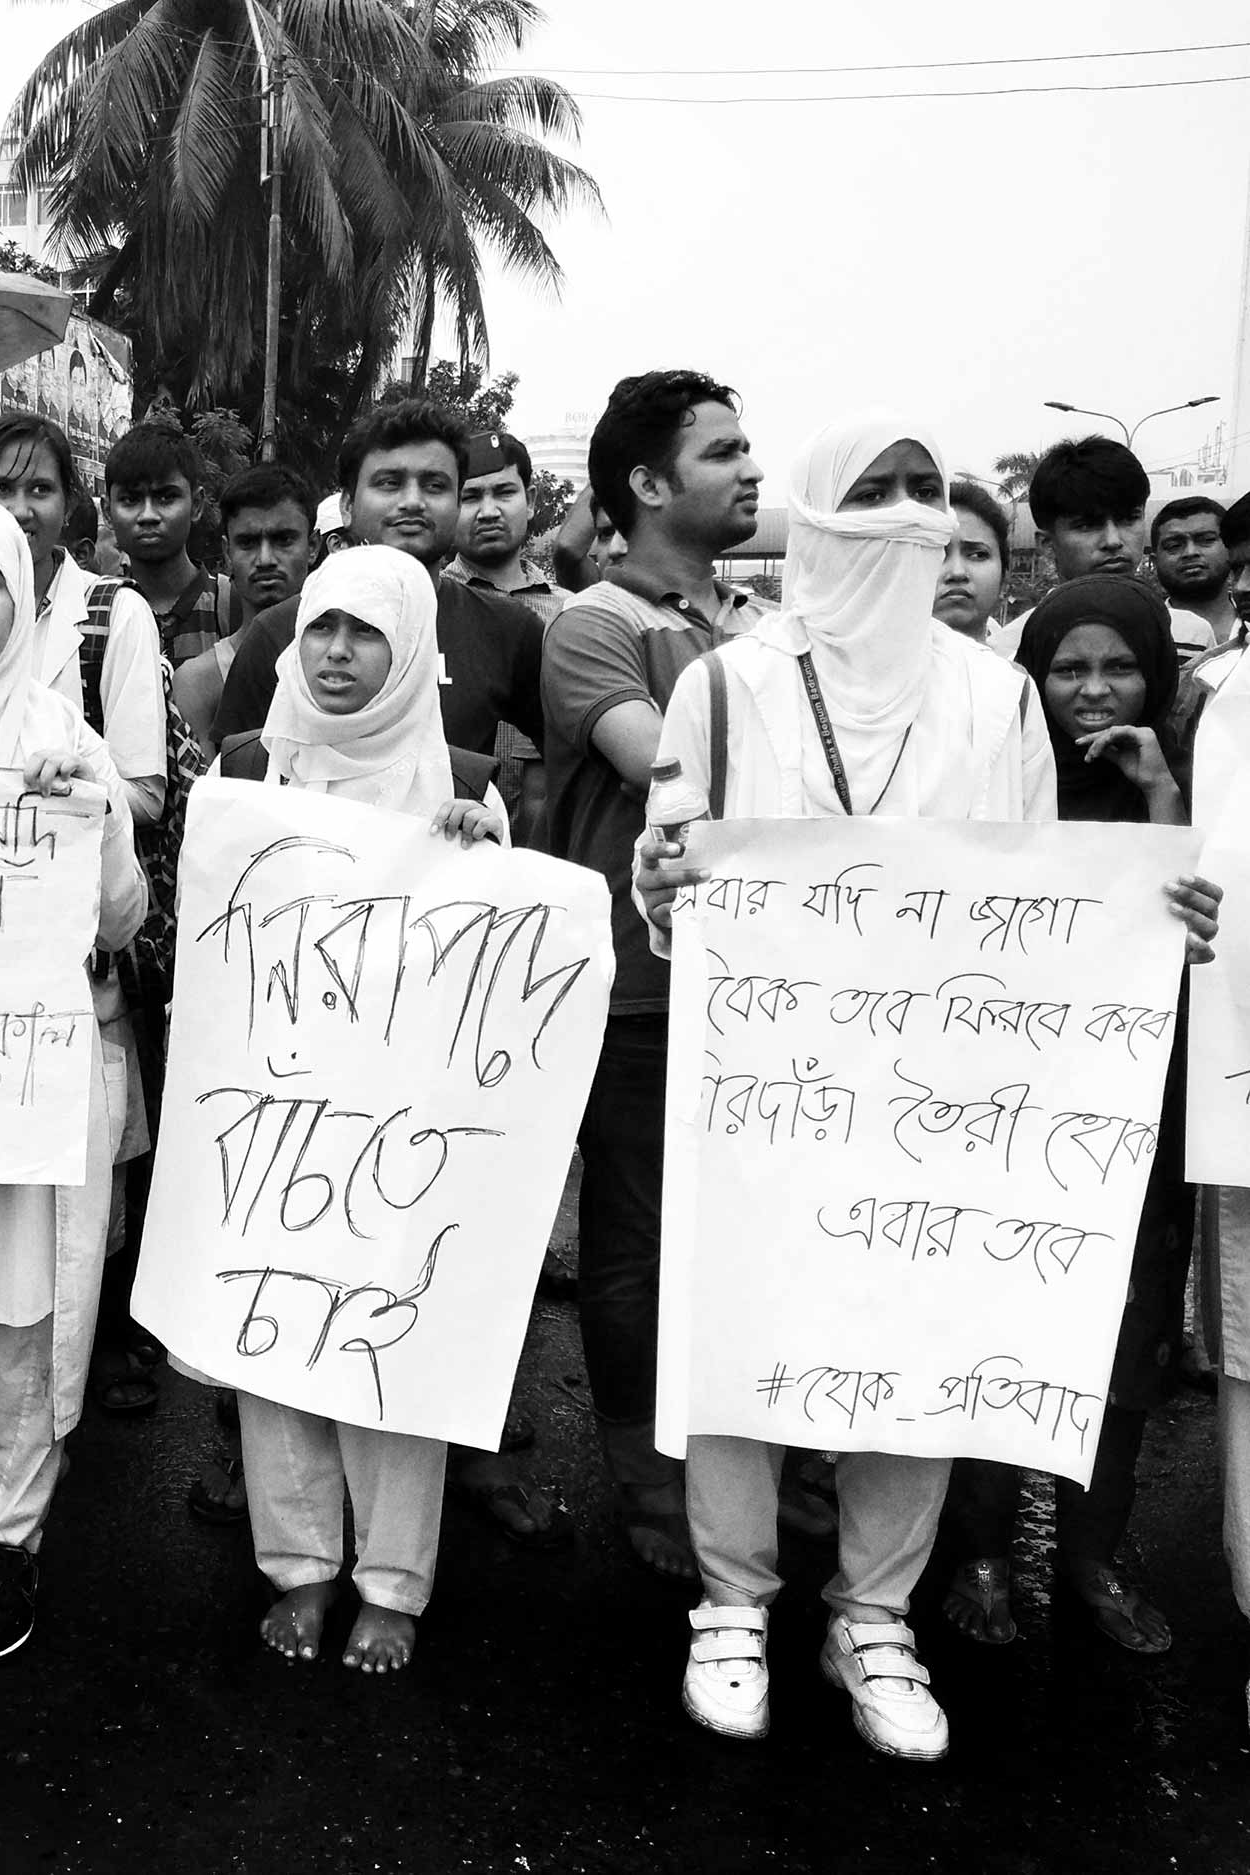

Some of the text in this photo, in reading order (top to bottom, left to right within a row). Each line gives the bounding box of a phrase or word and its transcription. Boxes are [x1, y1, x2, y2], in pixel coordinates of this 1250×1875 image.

[801, 863, 884, 936] যদি
[897, 889, 949, 939] না
[969, 894, 1104, 955] জাগো
[830, 988, 931, 1036] তবে
[937, 973, 1069, 1051] ফিরবে
[1084, 1003, 1176, 1061] কবে
[195, 1053, 507, 1239] বাঁচতে
[1046, 1107, 1159, 1192] হোক
[818, 1197, 1116, 1284] এবার তবে
[216, 1223, 461, 1421] চাই
